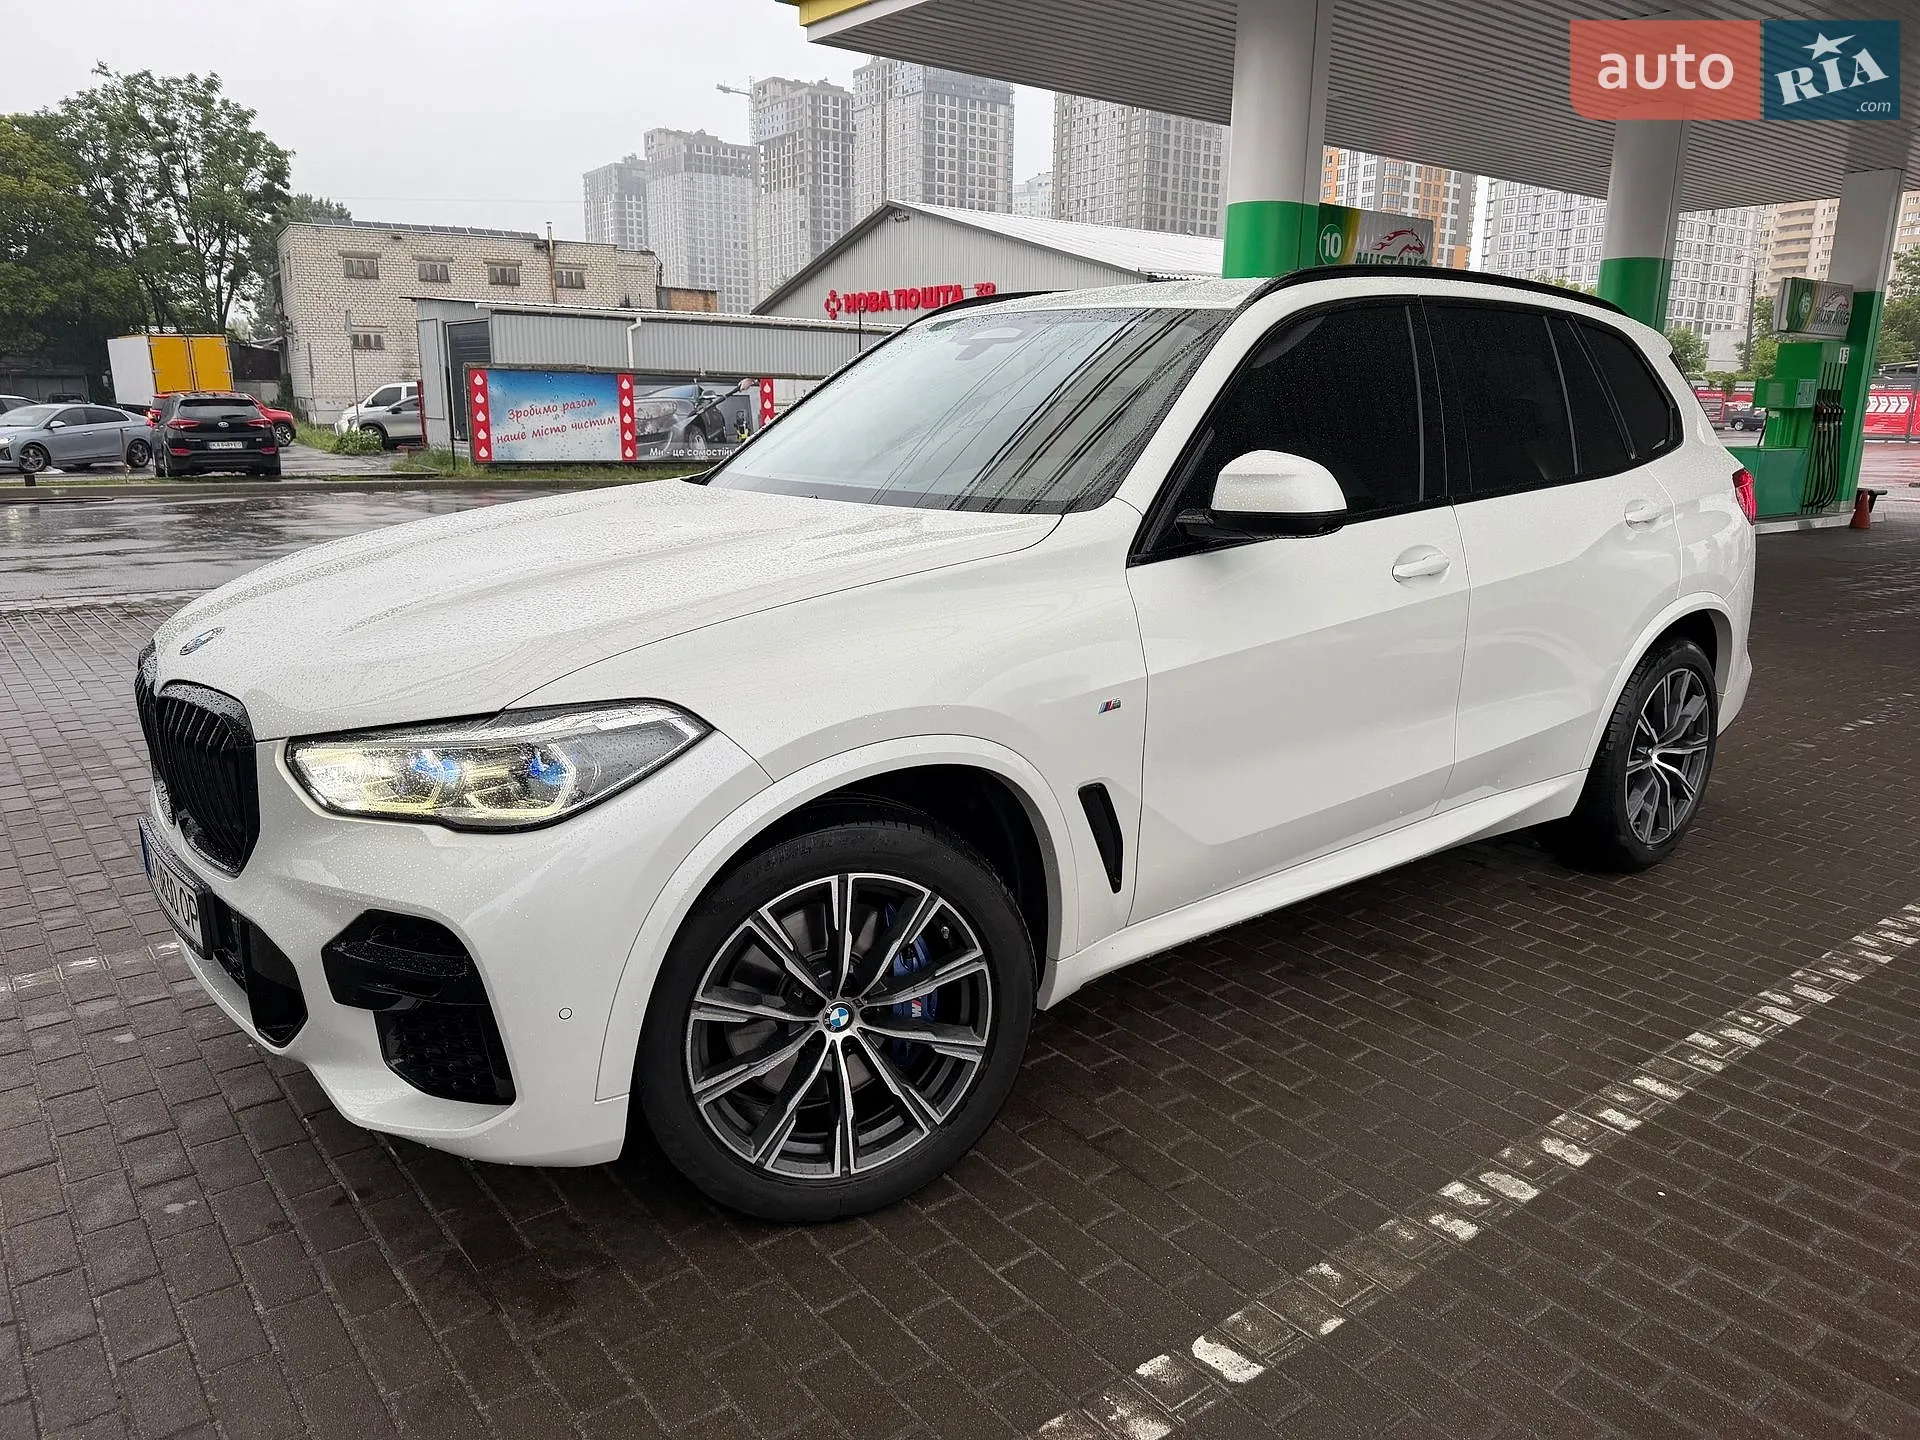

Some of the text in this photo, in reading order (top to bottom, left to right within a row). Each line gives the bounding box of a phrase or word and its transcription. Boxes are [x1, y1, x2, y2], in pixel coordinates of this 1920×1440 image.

[1323, 232, 1342, 258] 10
[843, 290, 891, 314] НОВА
[893, 284, 964, 310] ПОШТА
[507, 398, 597, 422] Зробимо разом
[496, 416, 617, 444] наше місто чистим
[649, 447, 665, 457] Ми
[672, 448, 685, 458] це
